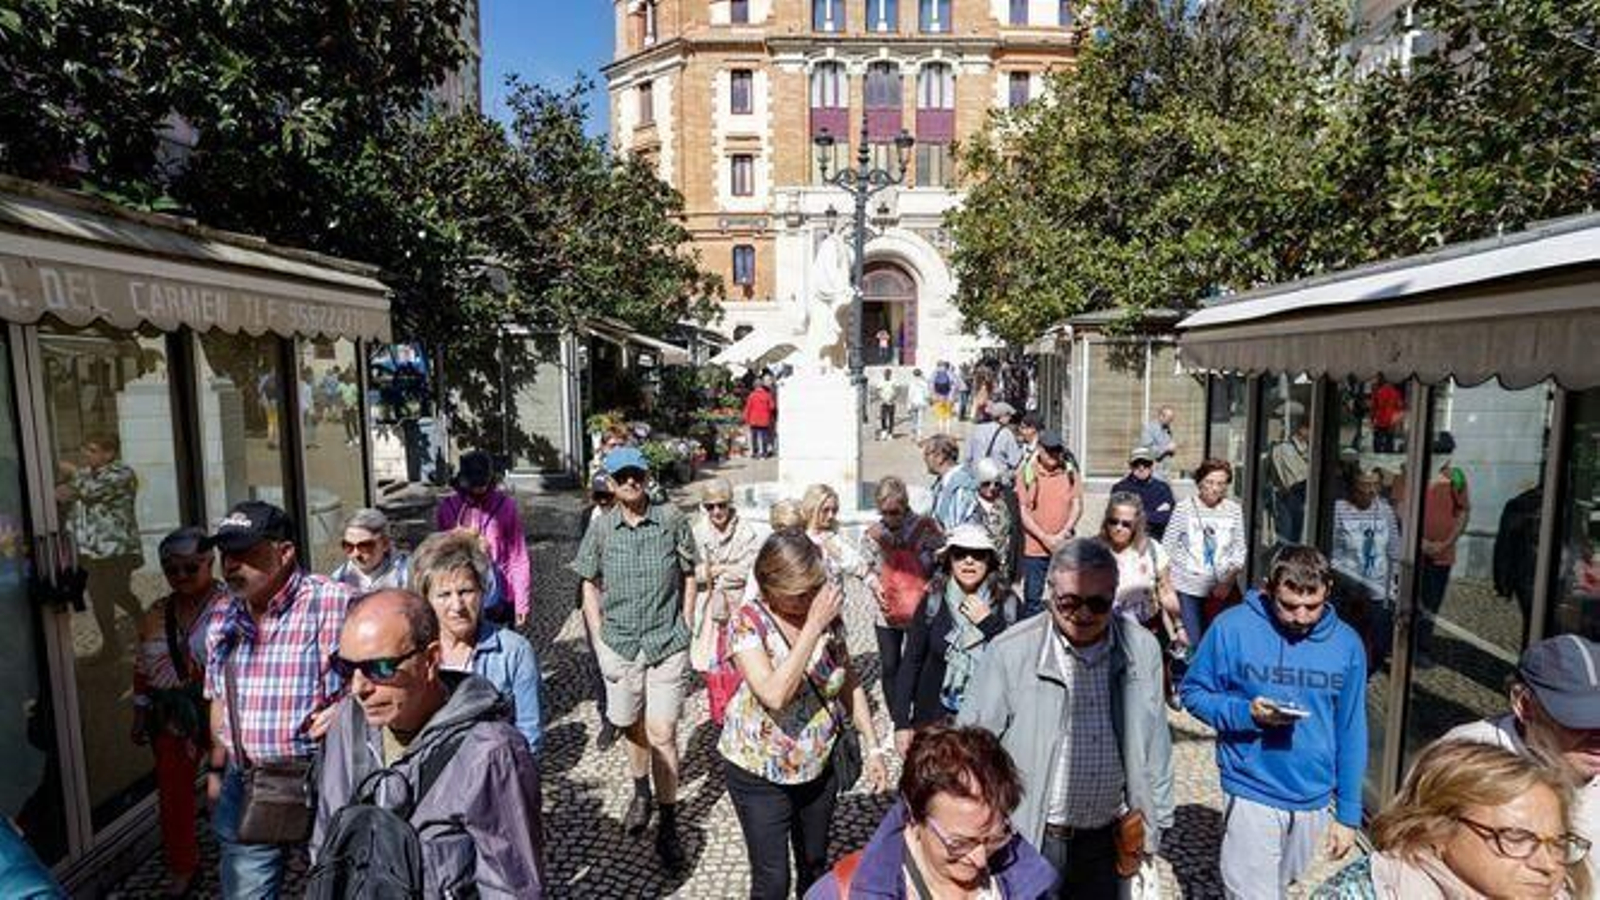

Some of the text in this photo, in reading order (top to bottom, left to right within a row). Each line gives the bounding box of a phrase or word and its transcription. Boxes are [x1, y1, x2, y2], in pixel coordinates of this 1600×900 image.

[39, 267, 110, 314] DEL
[130, 280, 229, 326] CARMEN
[1234, 660, 1343, 691] INSIDE
